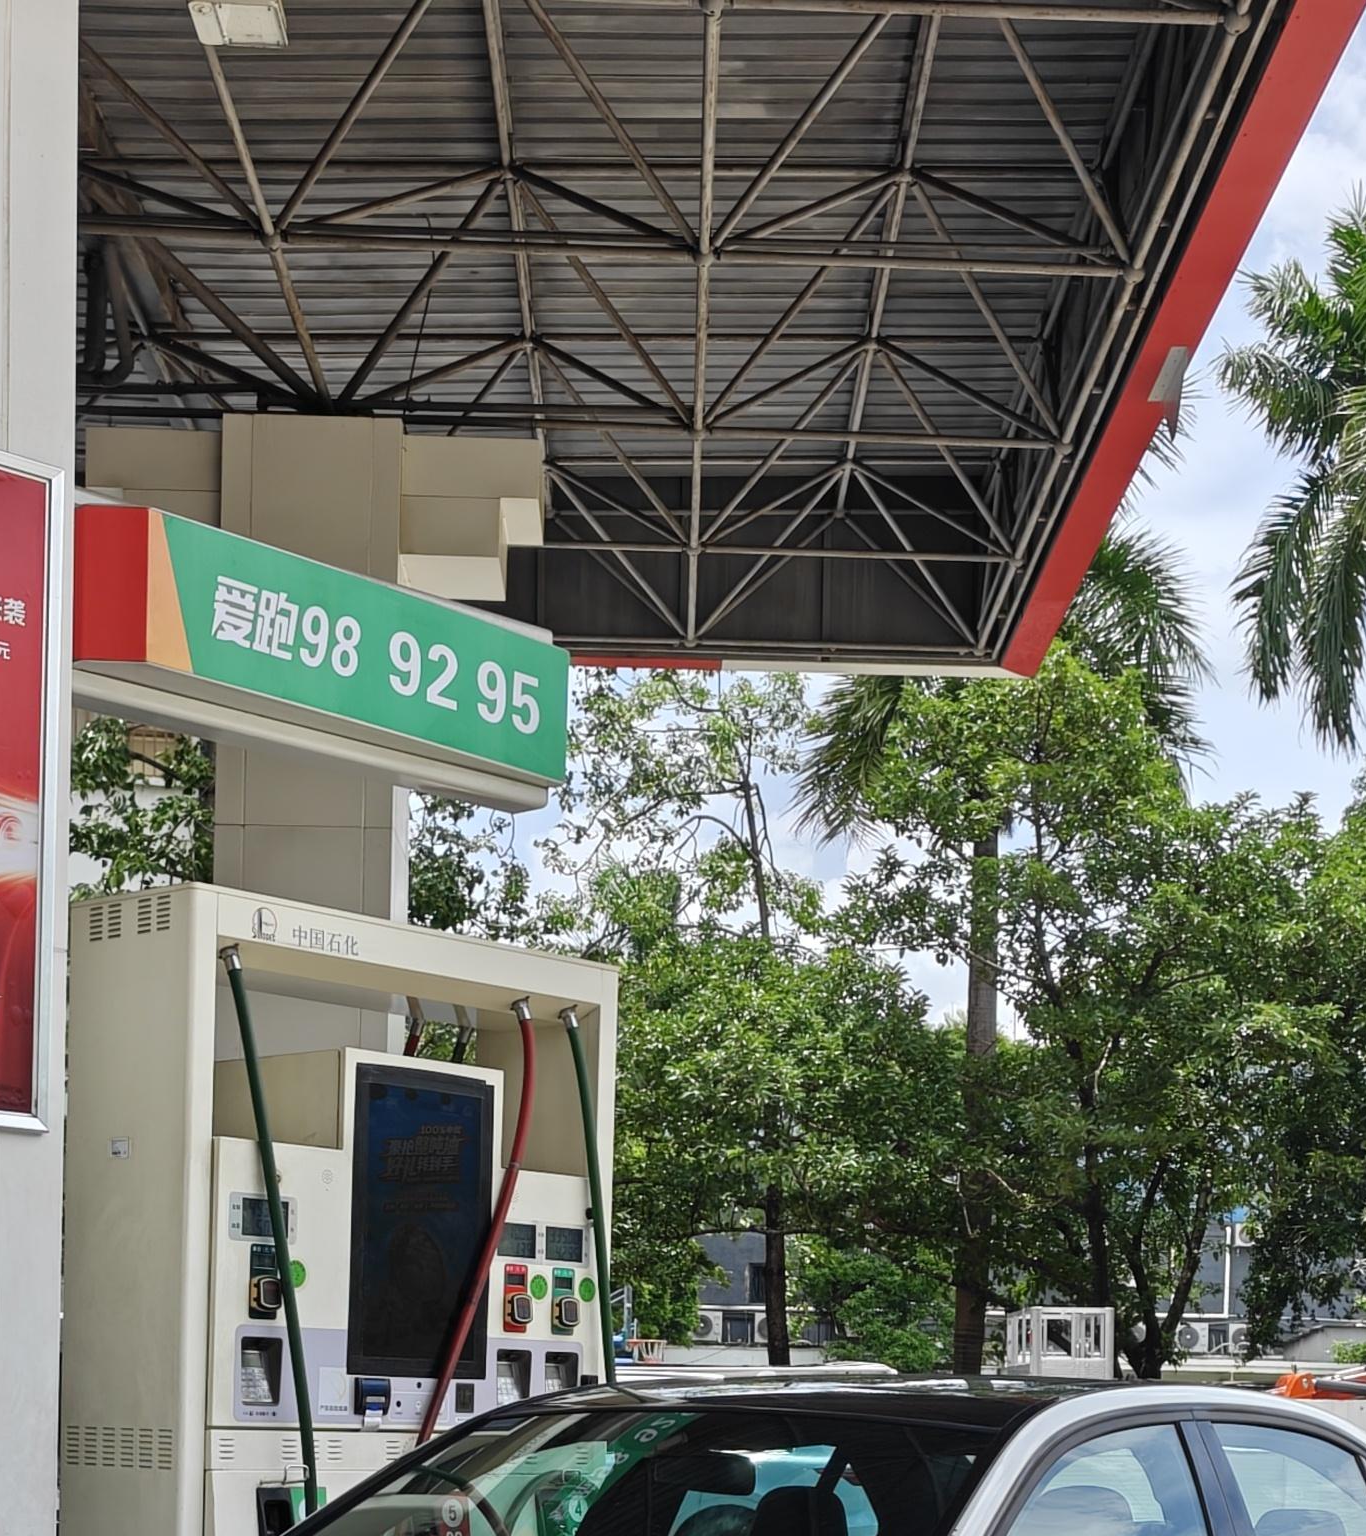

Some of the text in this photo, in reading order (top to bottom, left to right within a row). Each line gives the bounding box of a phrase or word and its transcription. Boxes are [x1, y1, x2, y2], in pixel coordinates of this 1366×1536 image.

[211, 574, 540, 735] 爱跑98 92 95
[292, 925, 359, 956] 中国石化
